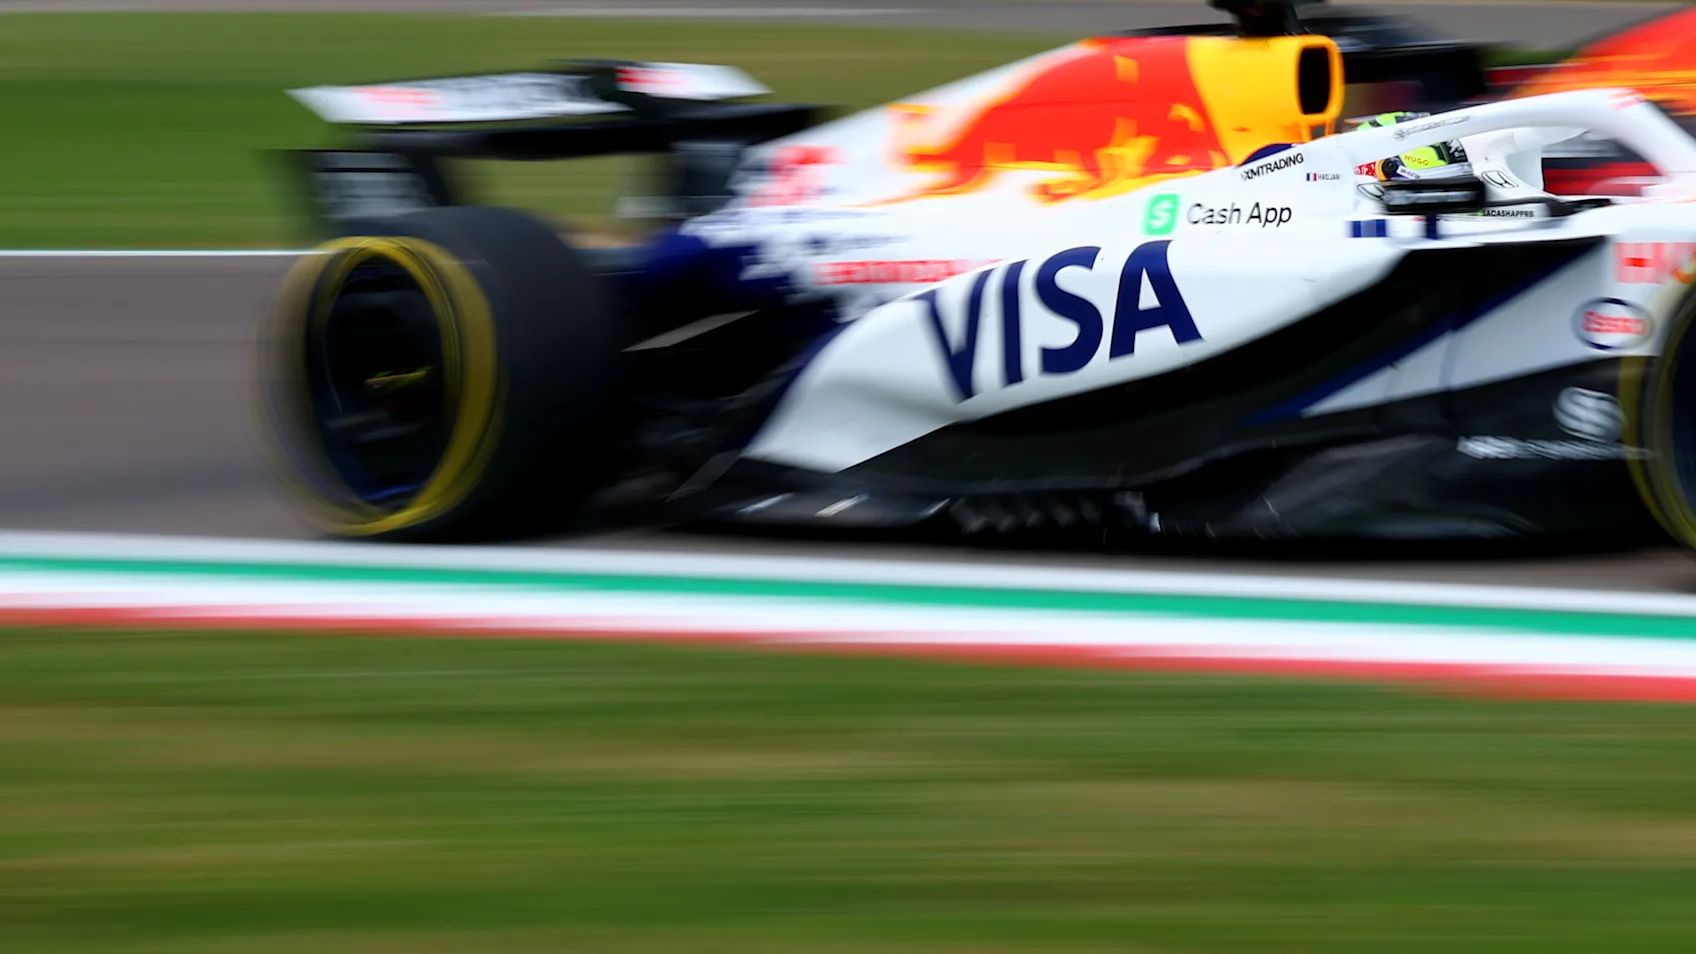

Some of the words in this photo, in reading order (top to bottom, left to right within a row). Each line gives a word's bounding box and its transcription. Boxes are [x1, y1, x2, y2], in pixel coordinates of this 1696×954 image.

[1404, 153, 1429, 166] HUGO
[1187, 202, 1242, 225] Cash
[1246, 202, 1292, 228] App
[911, 240, 1206, 405] VISA
